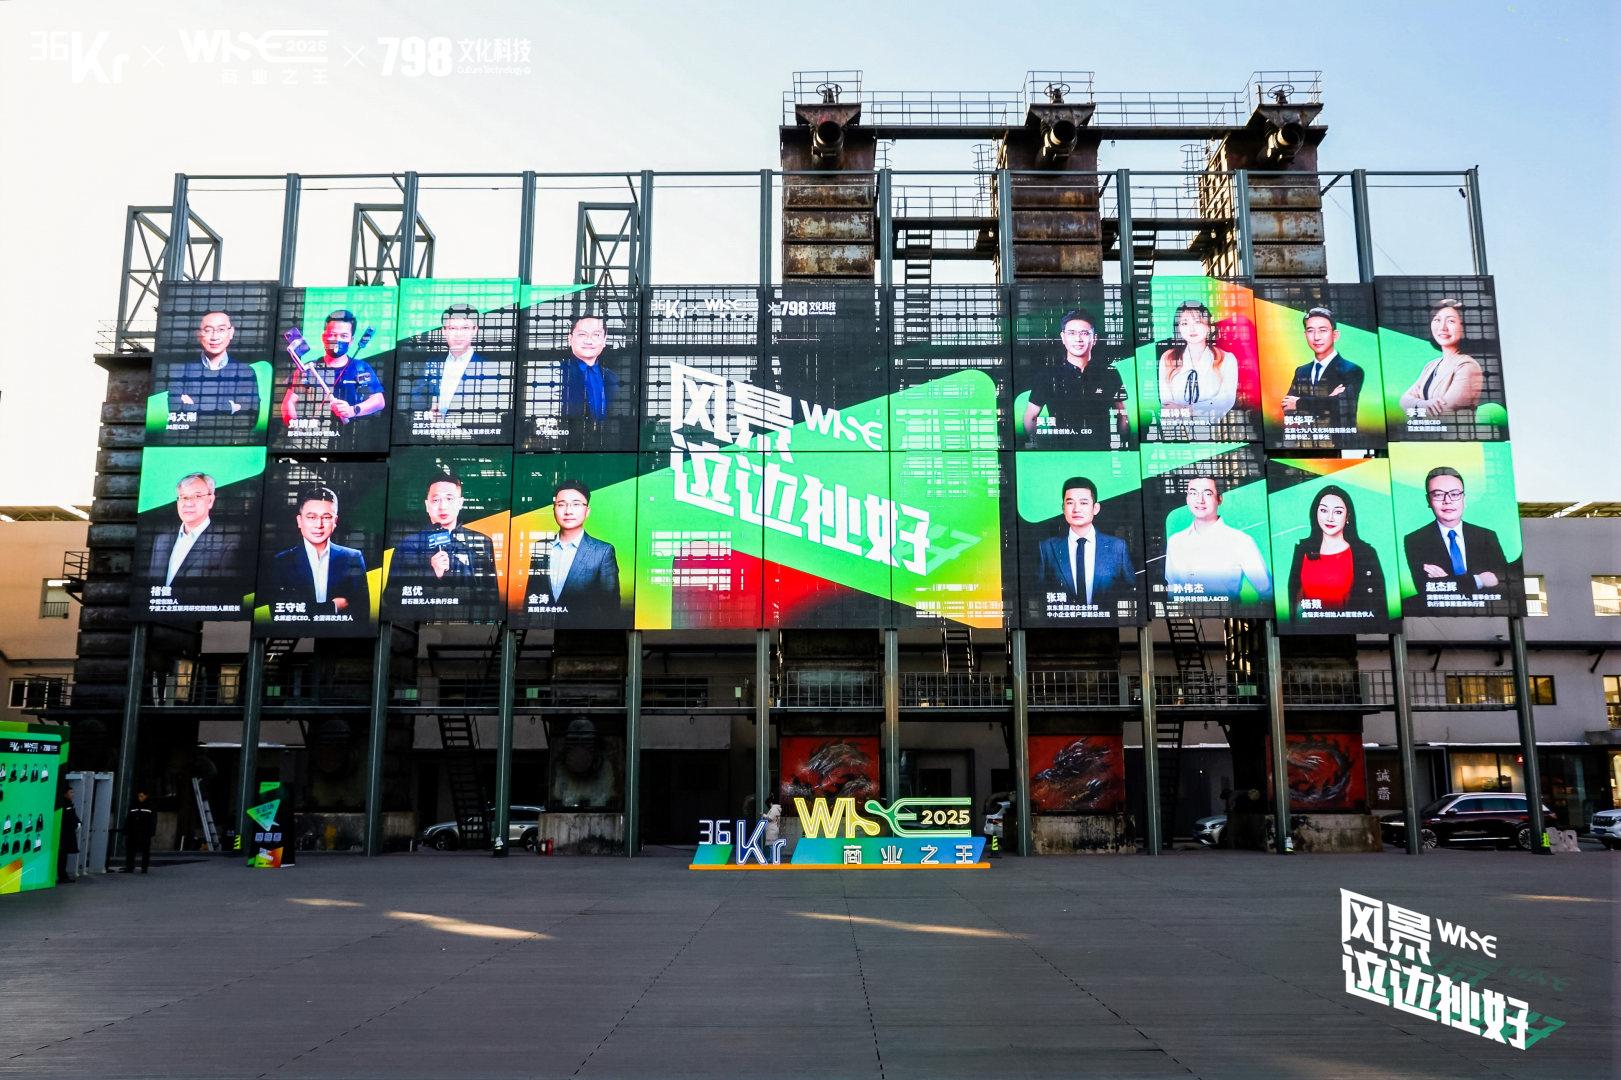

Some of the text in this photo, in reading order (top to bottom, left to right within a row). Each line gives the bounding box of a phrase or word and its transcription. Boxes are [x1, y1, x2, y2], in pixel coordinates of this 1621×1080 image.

[780, 301, 807, 315] 798
[168, 412, 197, 422] 冯大刚
[669, 361, 793, 463] 风景
[402, 586, 423, 596] 赵优
[1173, 583, 1204, 594] 孙伟杰
[528, 594, 549, 604] 金涛
[1046, 592, 1067, 602] 张瑞
[275, 603, 306, 613] 王守诚
[921, 810, 971, 825] 2025
[699, 819, 787, 865] 36Kr
[843, 845, 974, 865] 商业之王
